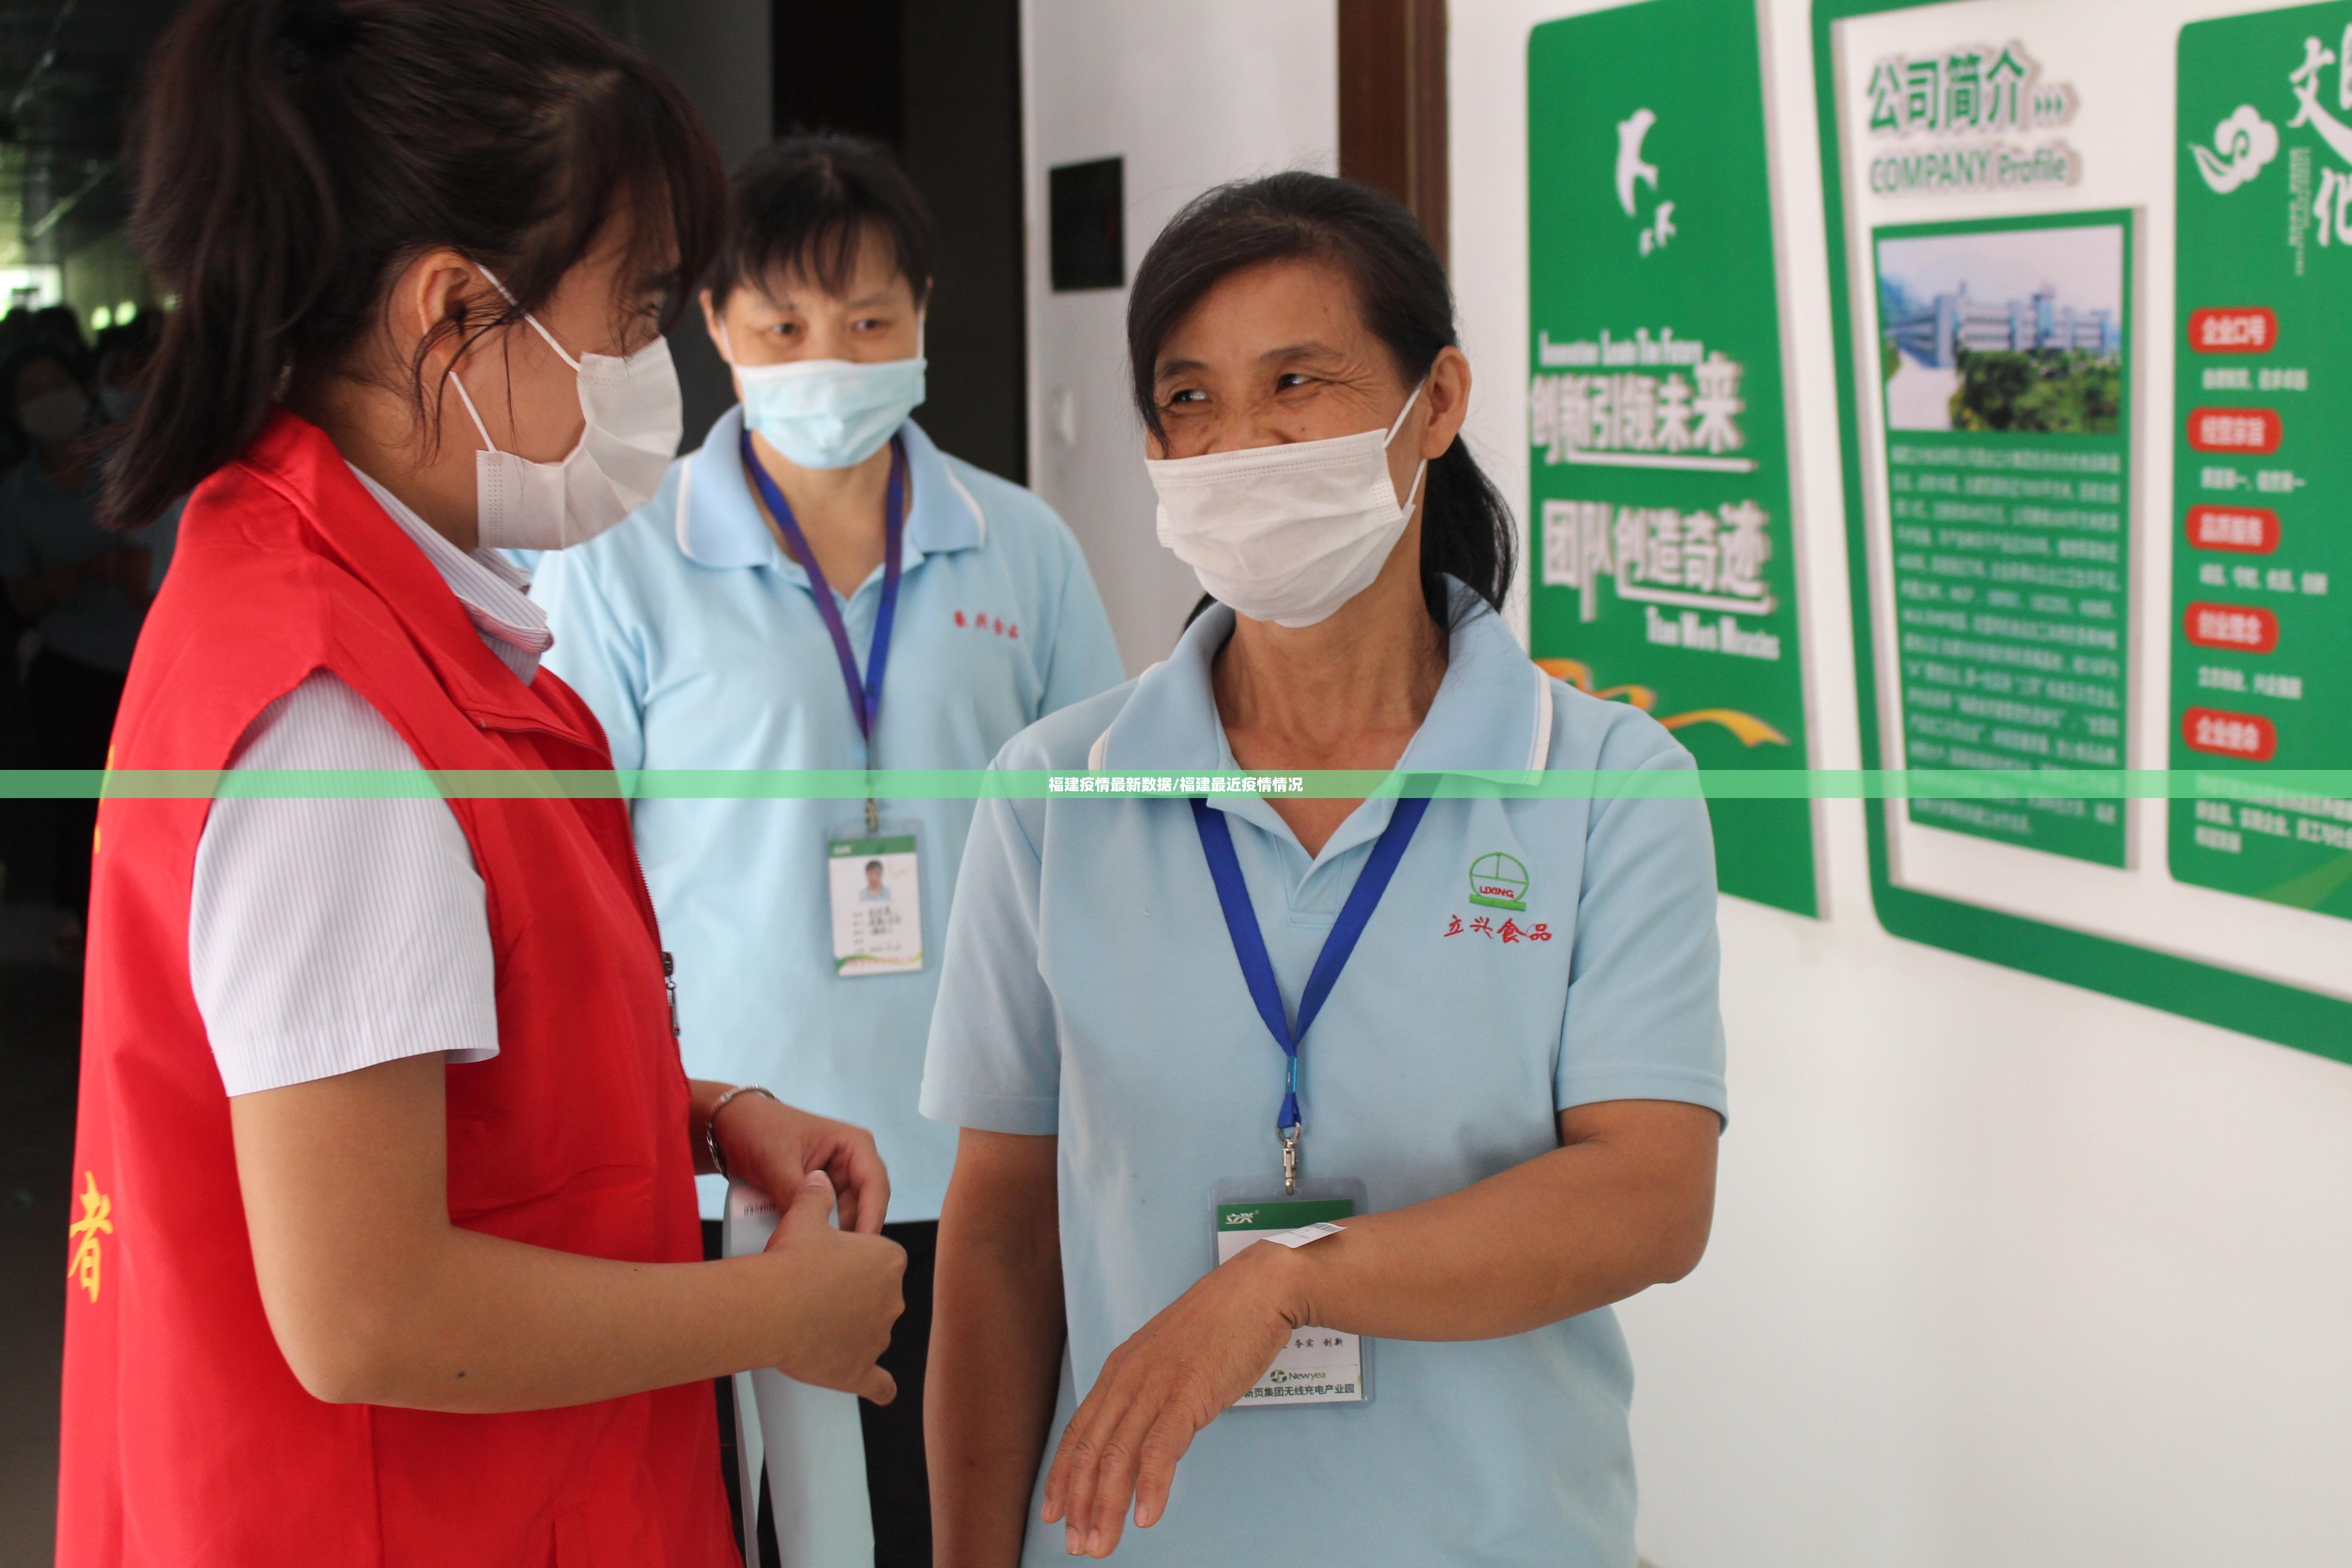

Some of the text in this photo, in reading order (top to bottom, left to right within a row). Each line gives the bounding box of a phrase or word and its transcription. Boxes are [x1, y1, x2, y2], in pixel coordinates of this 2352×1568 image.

[1867, 48, 2025, 131] 公司简介
[1869, 147, 2066, 194] COMPANY Profile
[1531, 351, 1749, 466] 创新引领未来
[1542, 499, 1773, 621] 团队创造奇迹
[1443, 913, 1553, 944] 立兴食品
[67, 1170, 113, 1303] 者
[1323, 1337, 1343, 1348] 创新
[1288, 1372, 1327, 1381] Newyea
